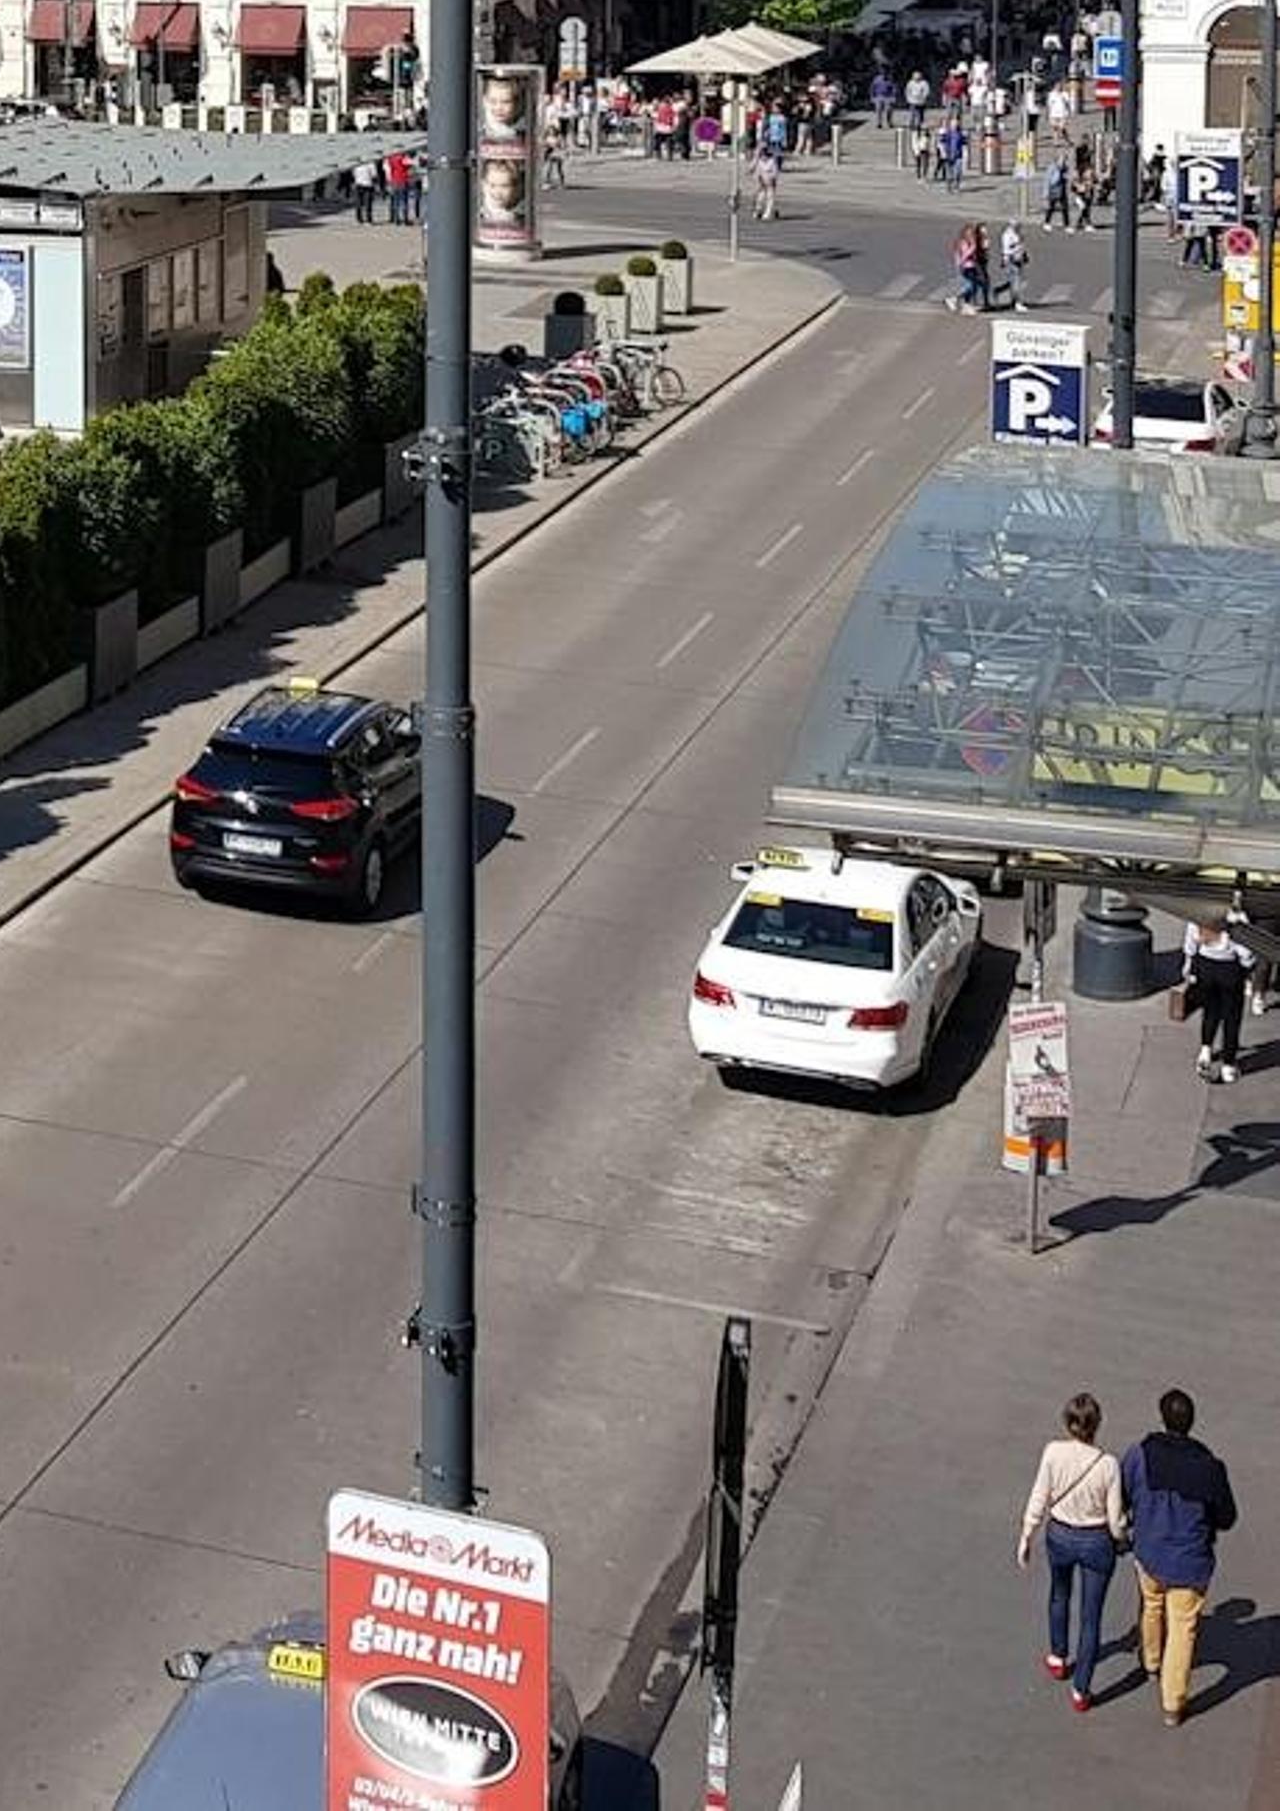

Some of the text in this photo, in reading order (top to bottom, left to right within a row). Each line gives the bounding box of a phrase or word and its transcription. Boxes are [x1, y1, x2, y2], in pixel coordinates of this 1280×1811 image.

[1187, 165, 1220, 202] P
[1009, 377, 1052, 430] P
[337, 1514, 535, 1583] Media Markt
[371, 1573, 502, 1636] Die Nr.1
[348, 1615, 436, 1663] ganz
[438, 1639, 524, 1685] nah!
[433, 1717, 502, 1753] MITTE
